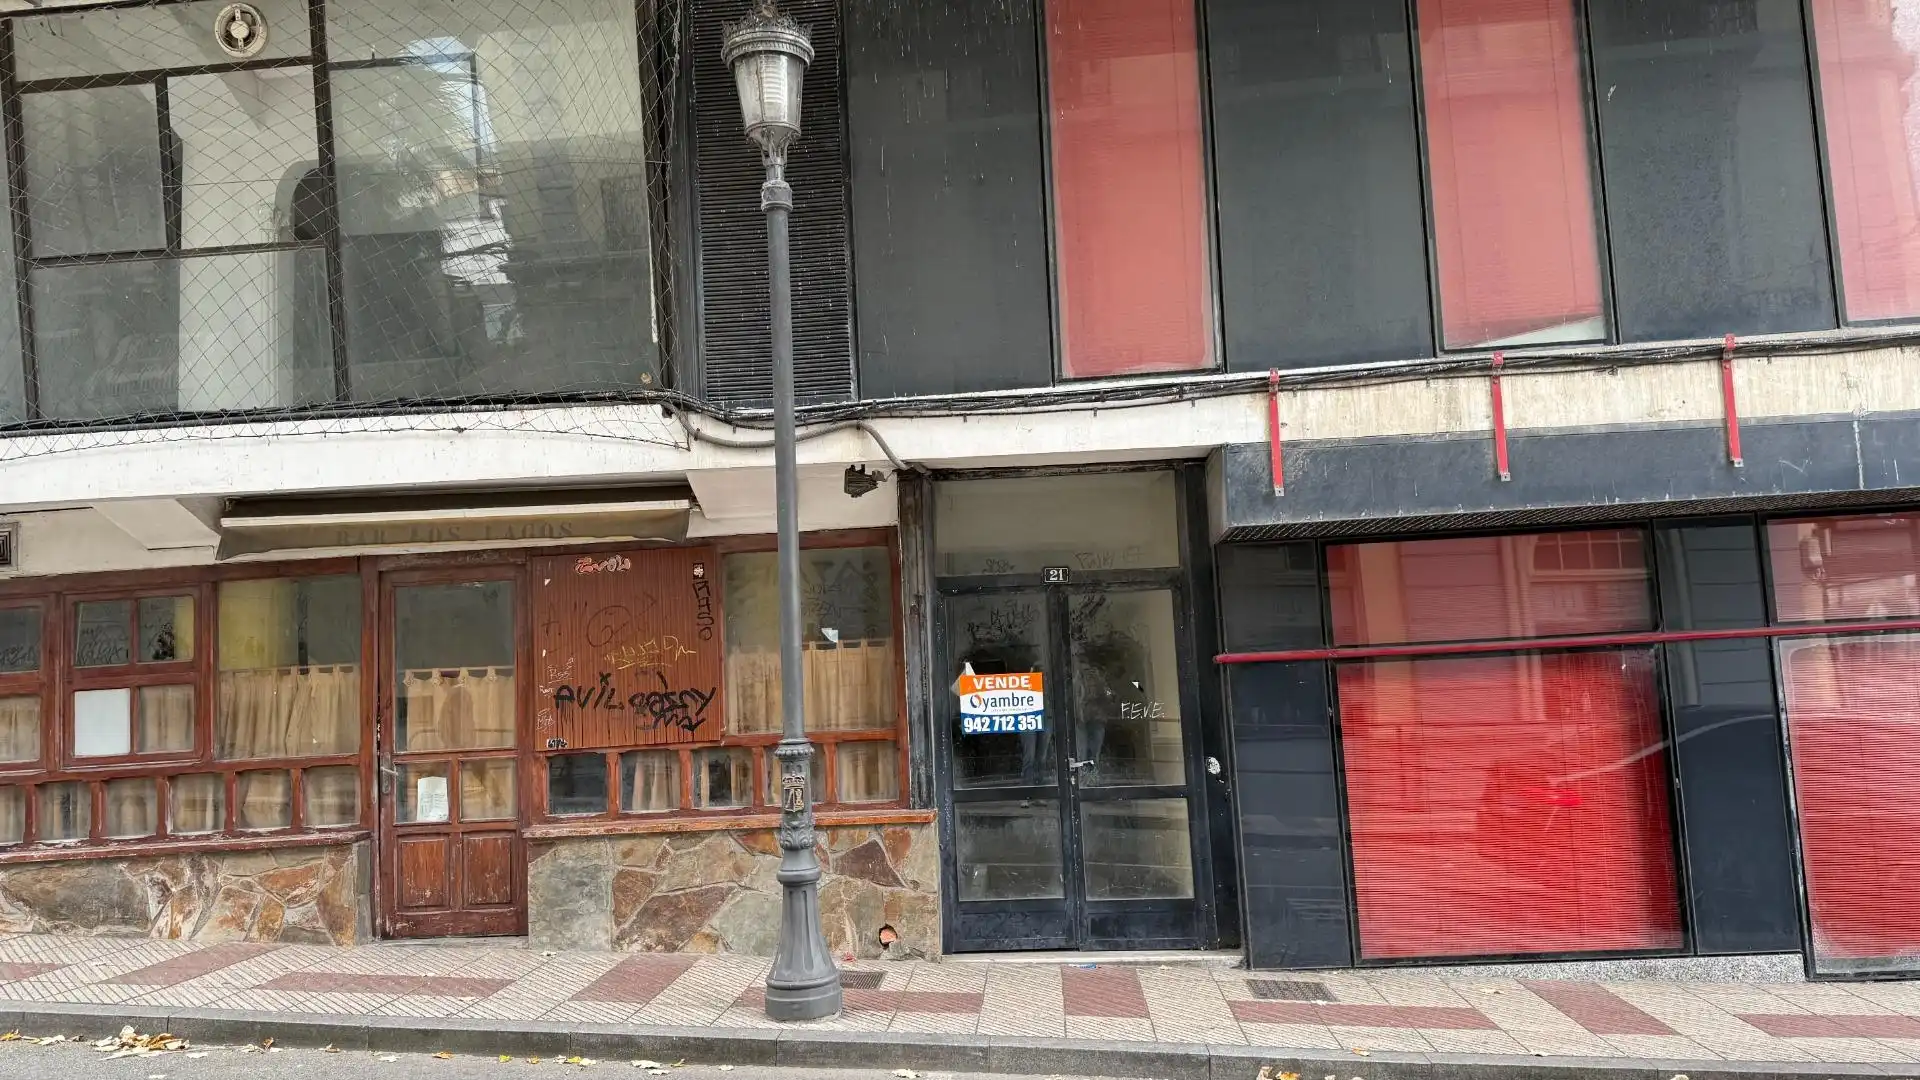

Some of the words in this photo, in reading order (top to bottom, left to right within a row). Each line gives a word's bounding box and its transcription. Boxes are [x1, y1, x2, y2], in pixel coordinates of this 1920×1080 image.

[336, 529, 386, 545] BAR
[484, 522, 574, 540] LAGOS
[1049, 569, 1064, 580] 21
[973, 675, 1031, 690] VENDE
[969, 692, 1034, 712] Oyambre
[964, 717, 990, 732] 942
[993, 716, 1015, 731] 712
[1018, 715, 1042, 731] 351
